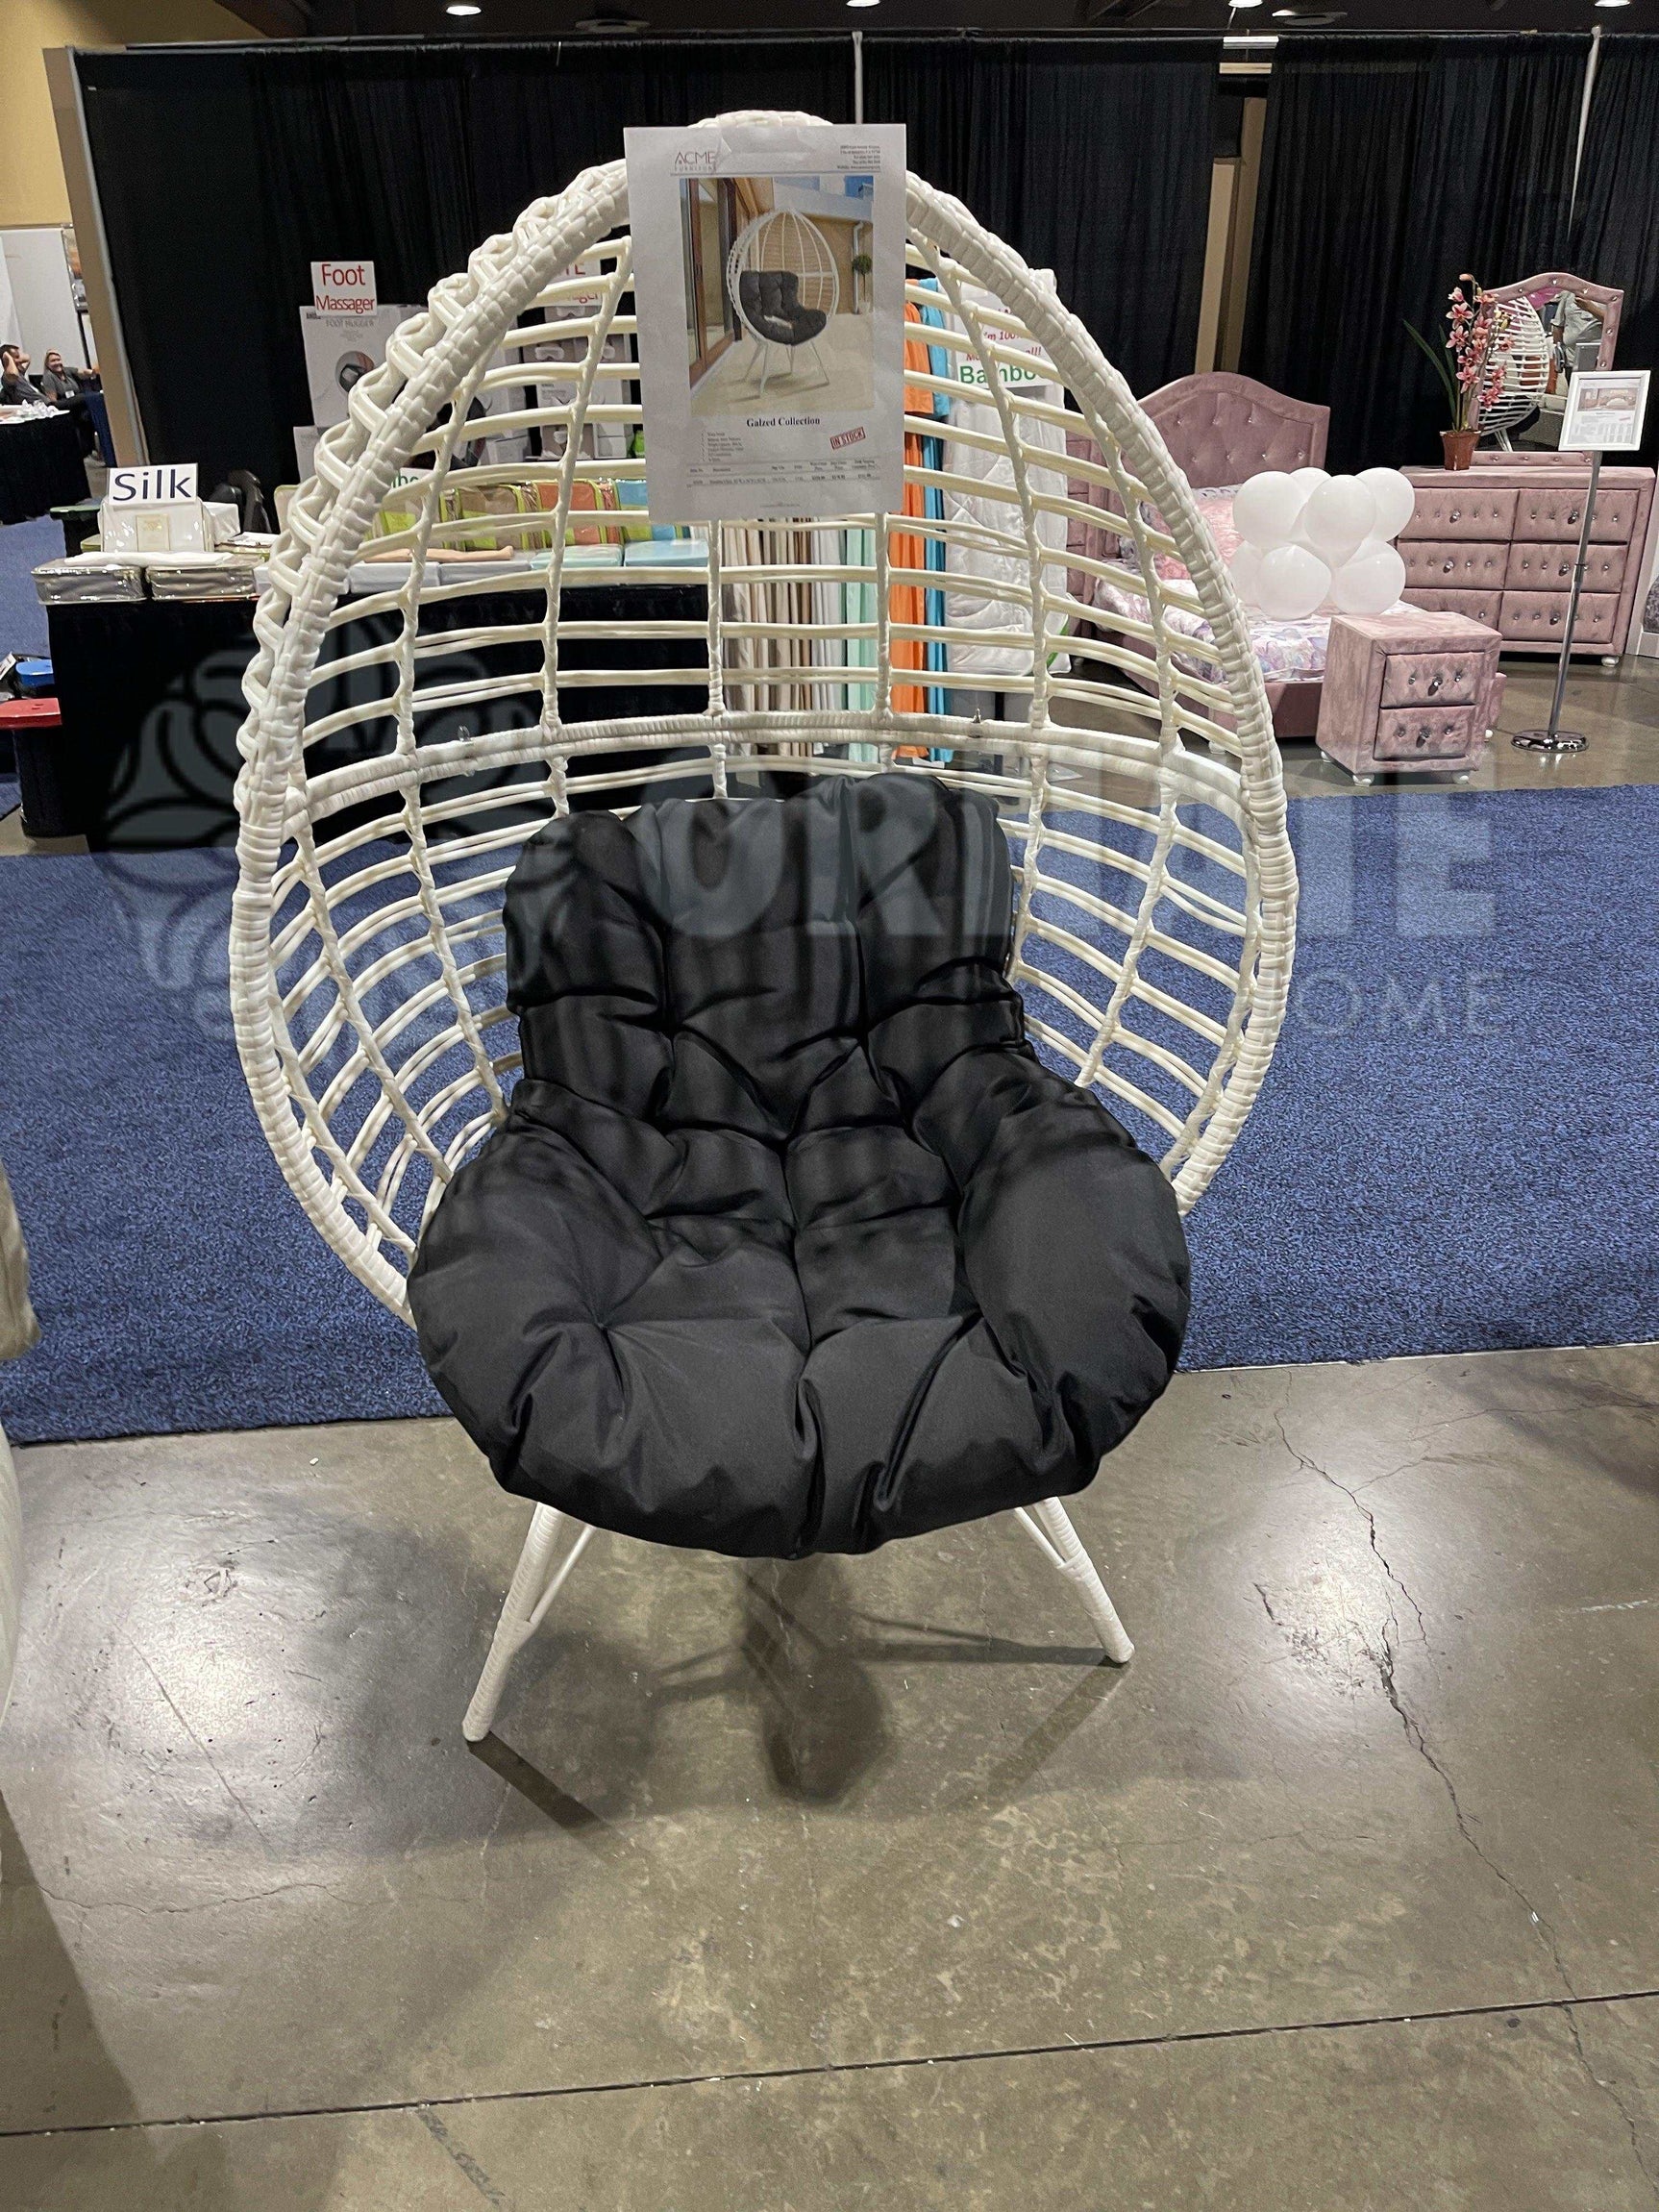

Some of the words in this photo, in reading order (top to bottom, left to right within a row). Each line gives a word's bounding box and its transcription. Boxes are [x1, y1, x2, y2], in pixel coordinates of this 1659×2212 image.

[674, 151, 716, 164] ACME
[321, 263, 366, 286] Foot
[315, 295, 376, 314] Massager
[746, 418, 776, 428] Galzed
[778, 416, 821, 427] Collection
[841, 428, 863, 445] STOCK
[112, 468, 192, 502] Silk
